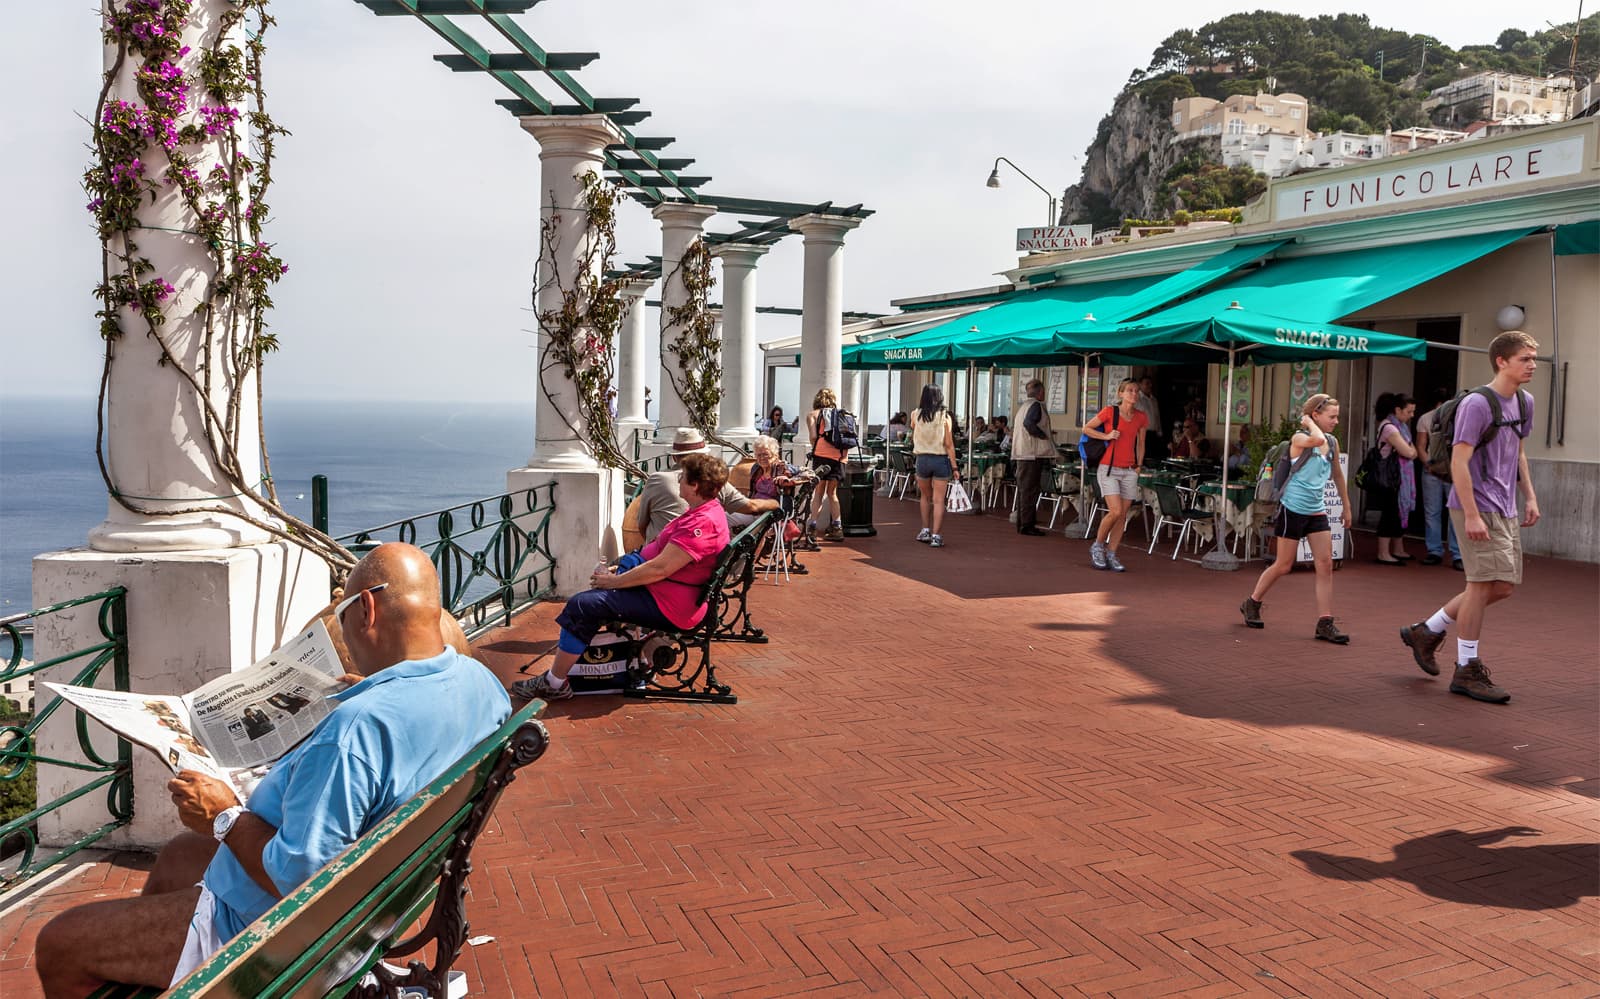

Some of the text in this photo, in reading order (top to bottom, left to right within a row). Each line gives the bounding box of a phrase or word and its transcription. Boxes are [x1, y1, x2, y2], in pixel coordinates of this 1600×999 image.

[1303, 149, 1543, 213] FUNICOLARE
[1032, 227, 1075, 239] PIZZA
[1019, 237, 1088, 249] SNACK BAR
[1274, 327, 1369, 352] SNACK BAR
[883, 348, 923, 360] SNACK BAR
[579, 663, 618, 674] MONACO
[206, 696, 235, 711] Magistris
